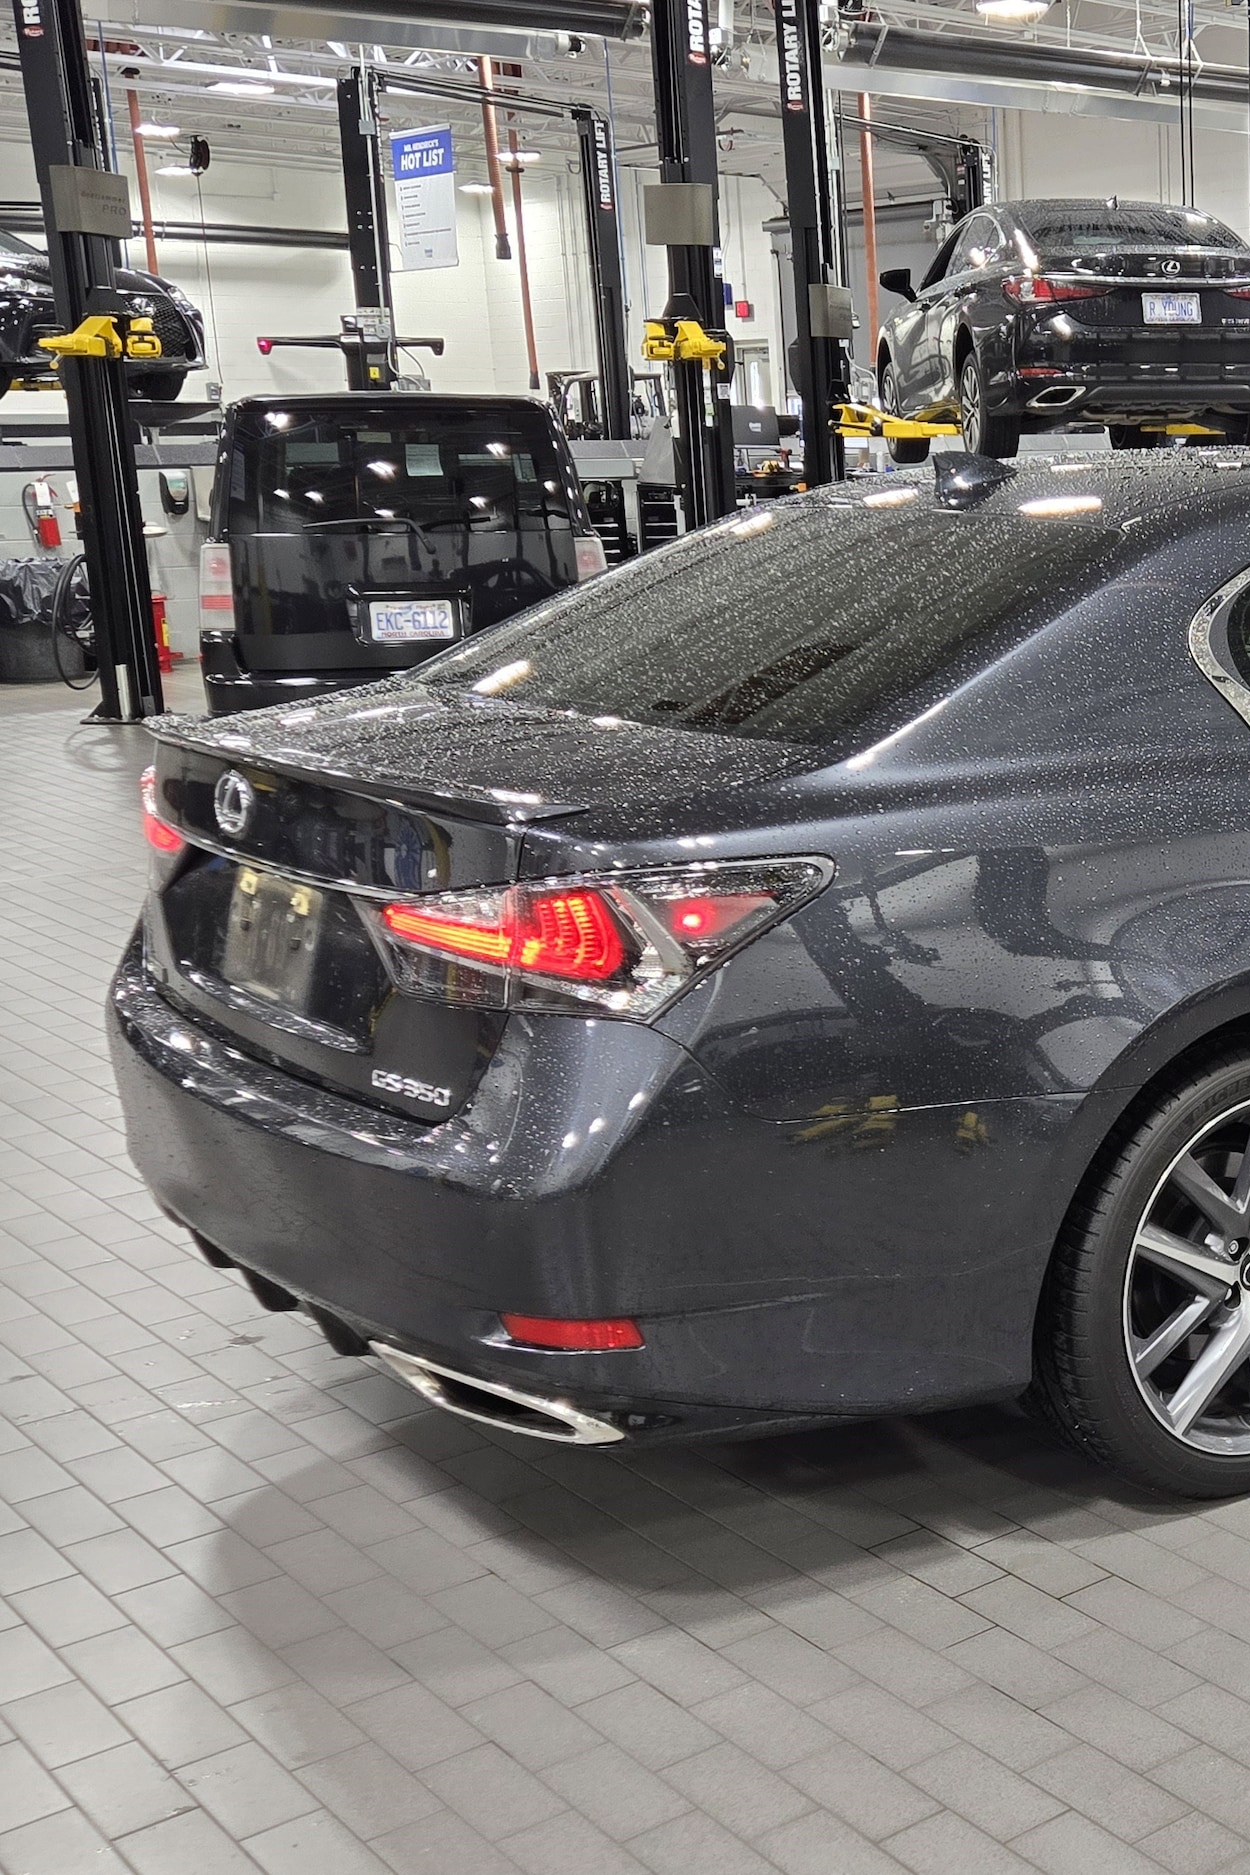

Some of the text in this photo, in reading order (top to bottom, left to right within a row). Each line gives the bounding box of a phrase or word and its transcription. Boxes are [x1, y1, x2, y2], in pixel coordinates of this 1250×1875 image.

[783, 23, 802, 100] ROTARY
[401, 147, 445, 171] HOT LIST
[594, 121, 612, 203] ROTARY LIFT
[981, 153, 991, 179] LIFT
[102, 204, 127, 216] PRO
[1149, 301, 1193, 316] R YOUNG
[376, 610, 449, 631] EKC-6112
[409, 630, 446, 638] CAROLINA
